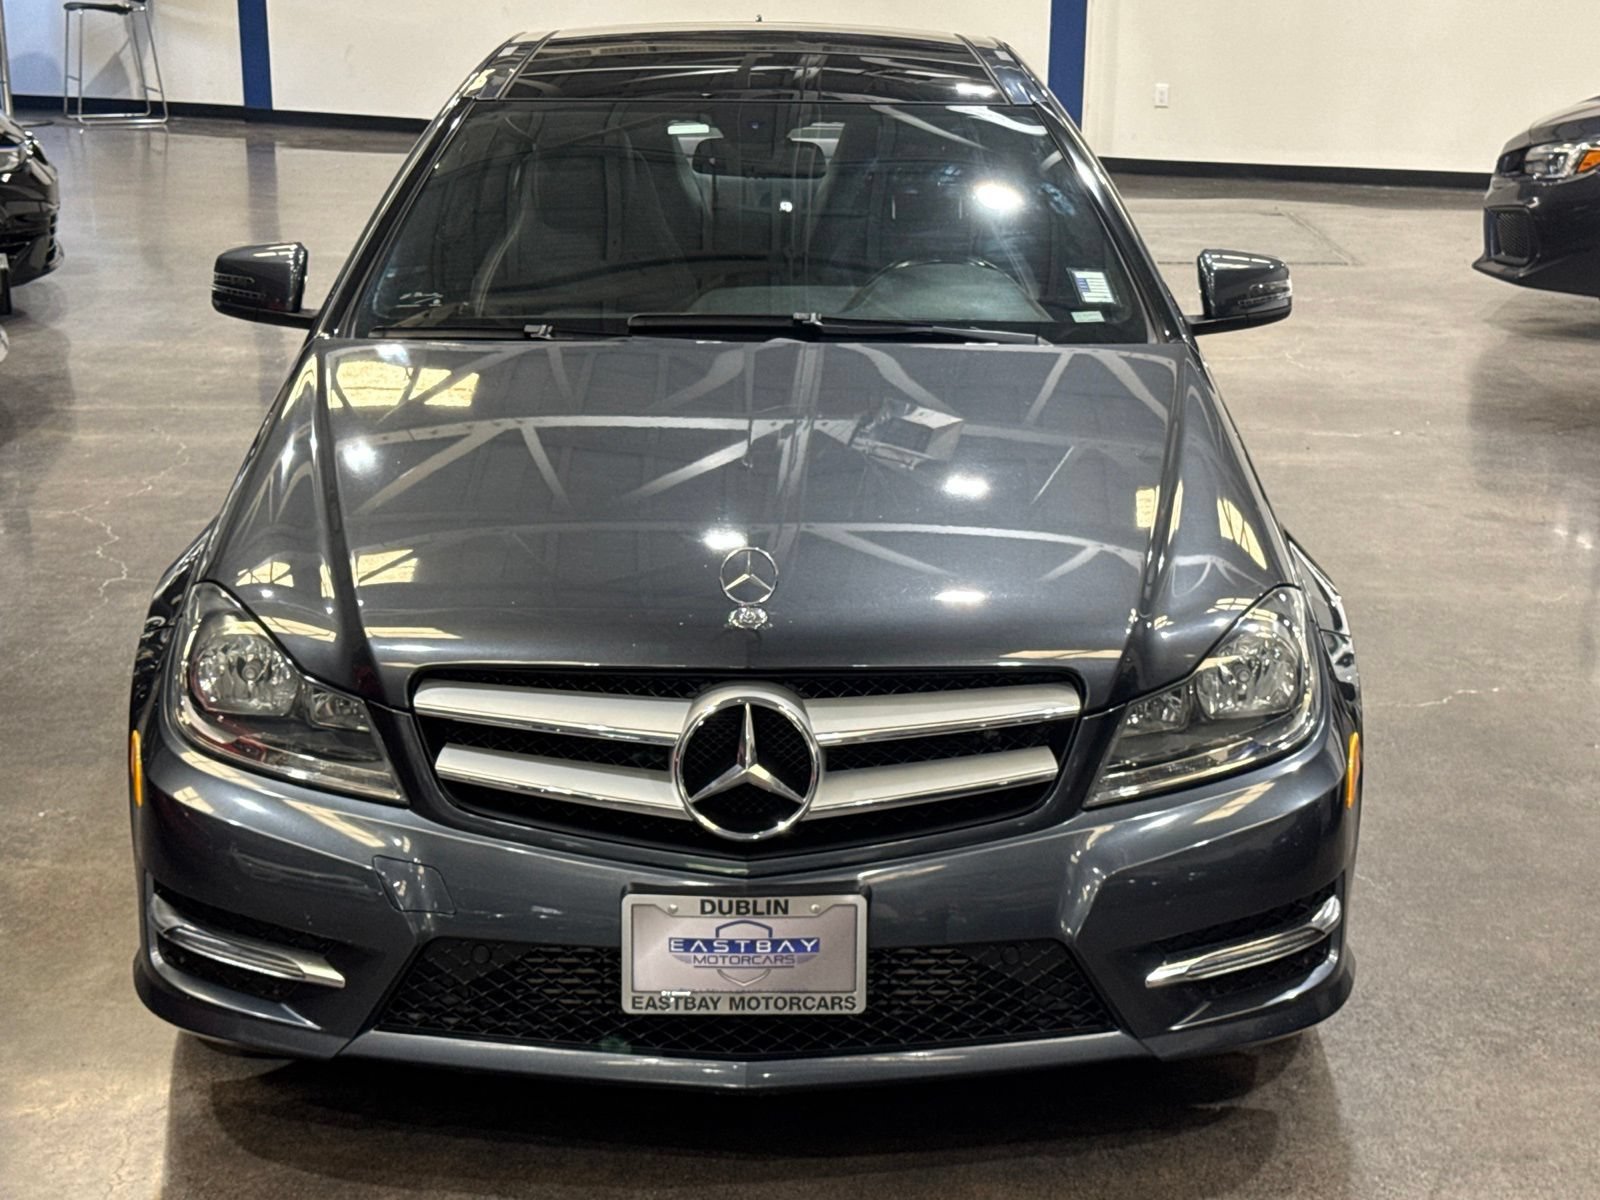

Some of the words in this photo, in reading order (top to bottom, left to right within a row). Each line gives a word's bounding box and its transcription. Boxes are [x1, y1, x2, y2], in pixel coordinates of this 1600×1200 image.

[700, 899, 789, 915] DUBLIN
[670, 938, 818, 952] EASTBAY
[693, 954, 796, 965] MOTORCARS
[631, 996, 721, 1011] EASTBAY
[729, 996, 857, 1011] MOTORCARS
